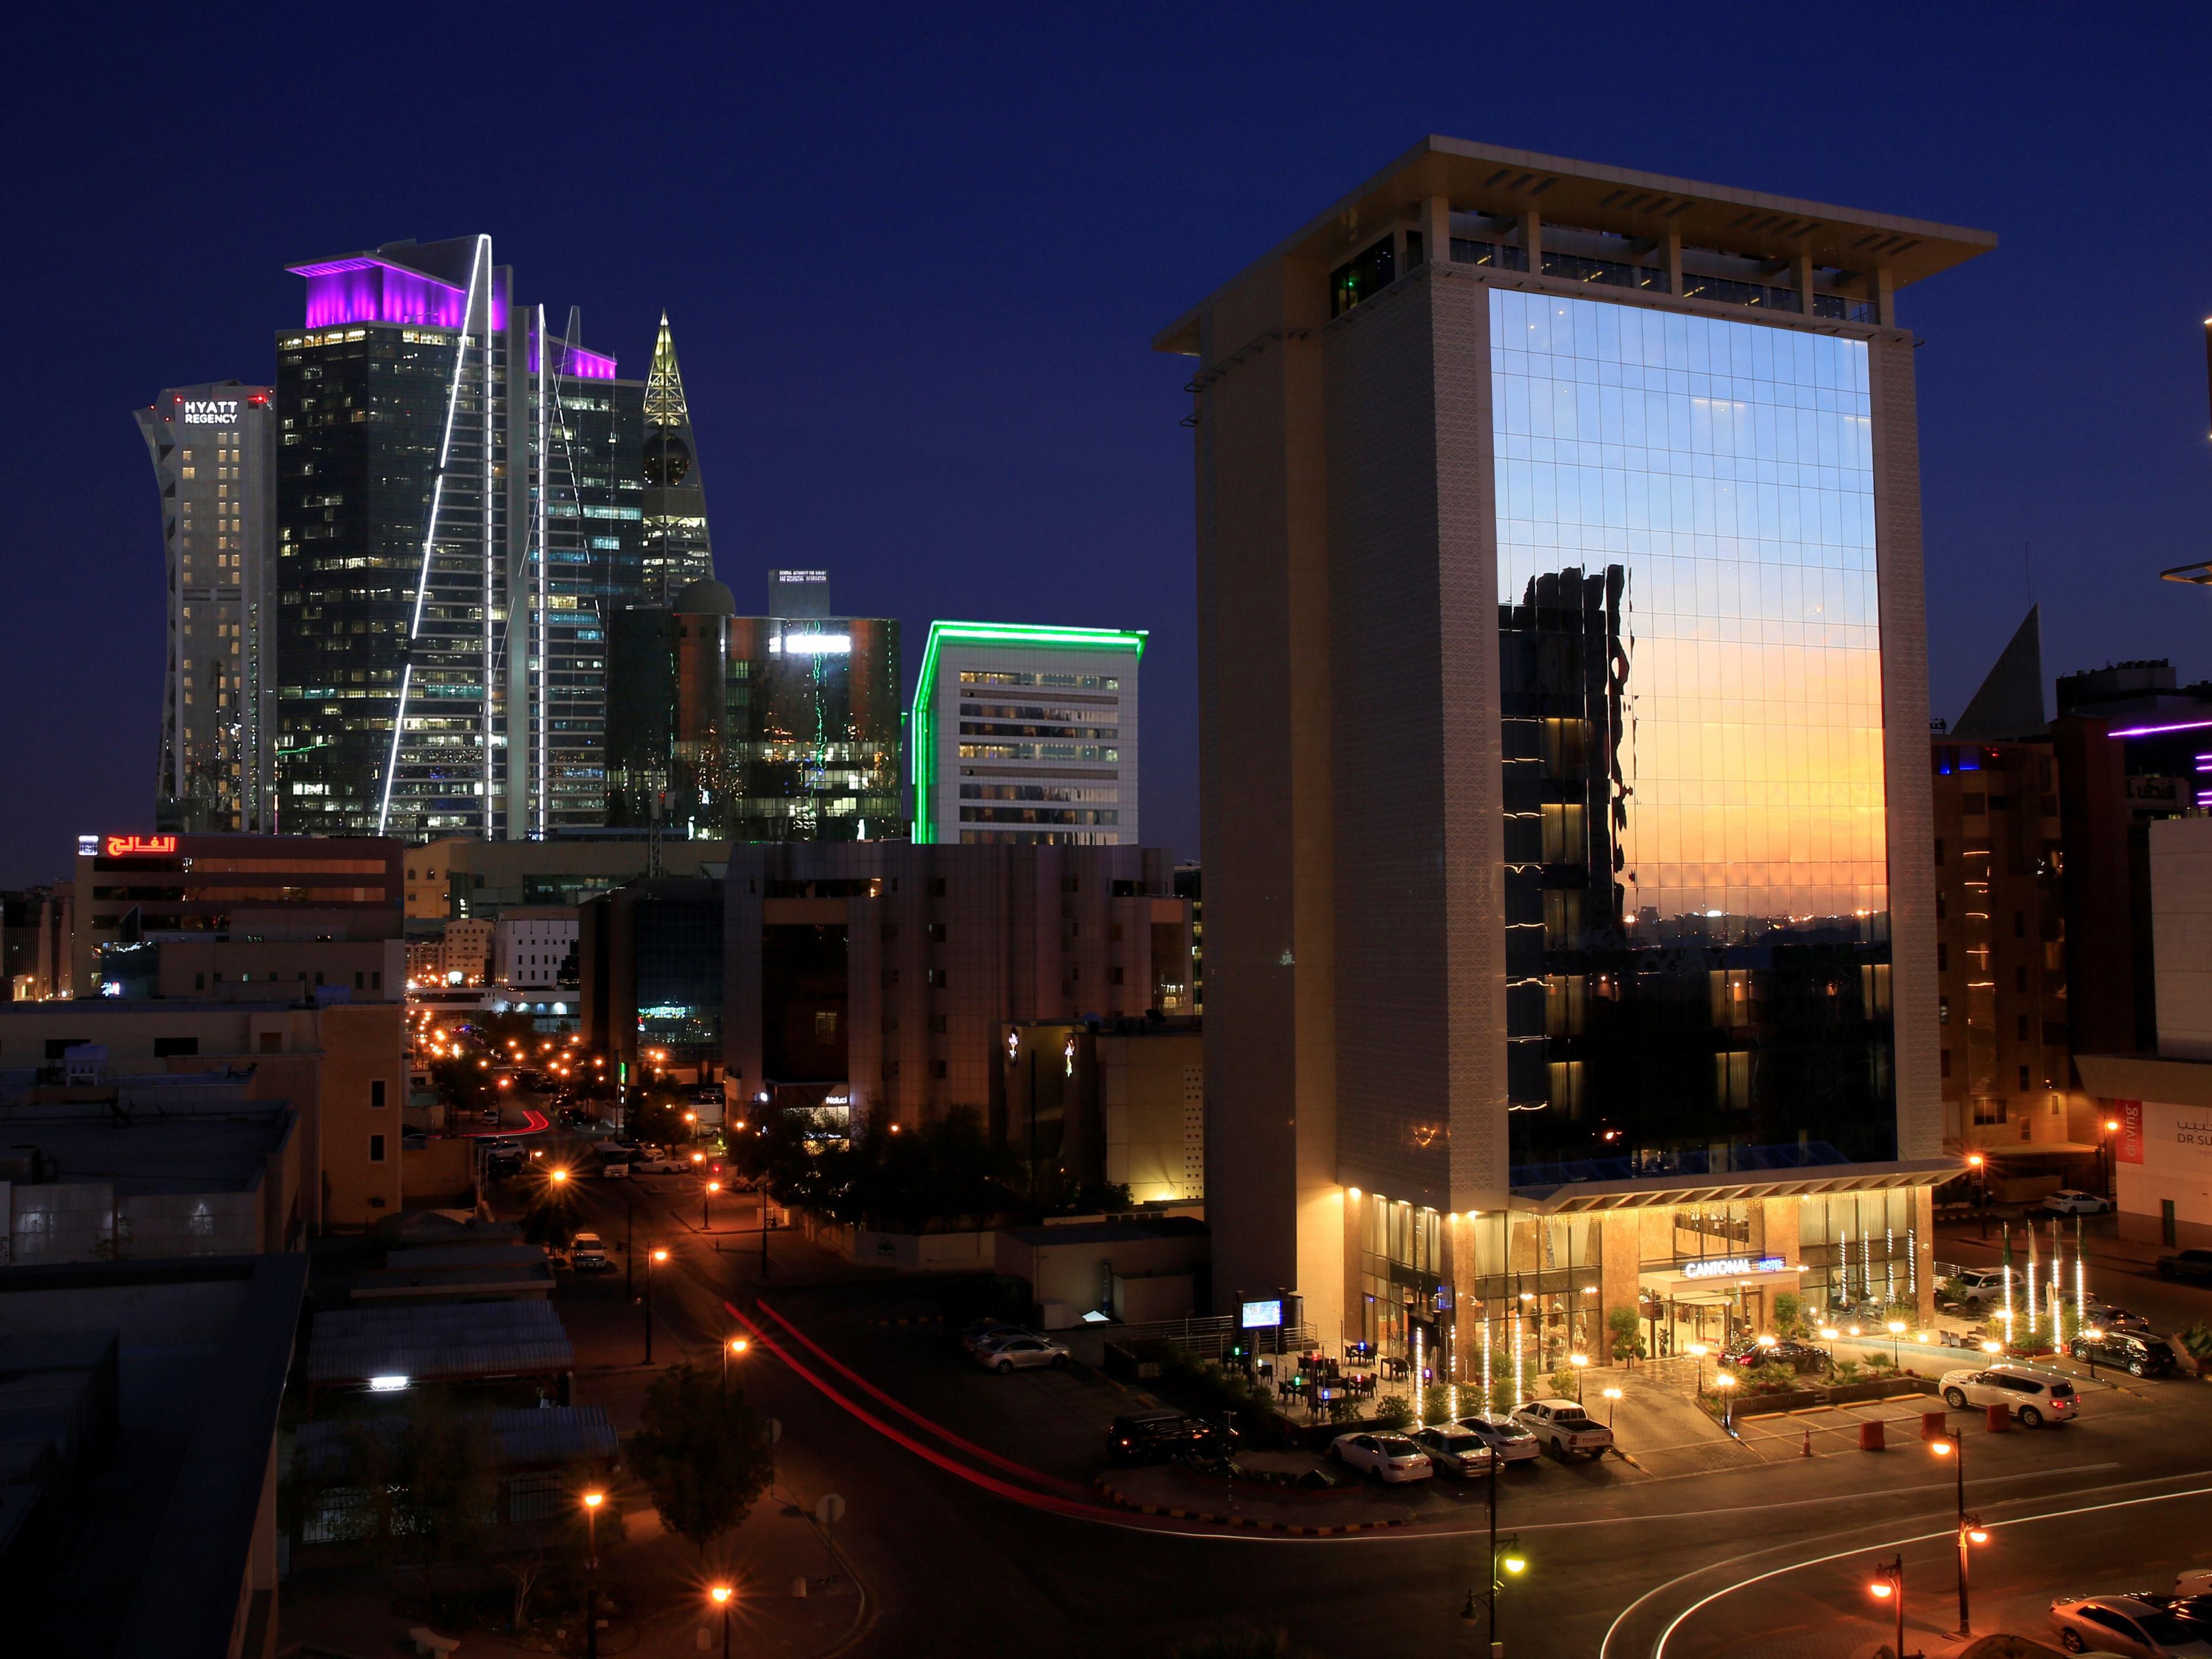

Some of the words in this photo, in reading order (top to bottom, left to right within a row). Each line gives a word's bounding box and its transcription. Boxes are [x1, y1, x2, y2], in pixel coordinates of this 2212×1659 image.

[185, 401, 238, 413] HYATT
[185, 414, 238, 424] REGENCY
[107, 836, 175, 856] الفالح
[2123, 1104, 2139, 1157] driving
[2177, 1133, 2194, 1144] DR
[1685, 1259, 1751, 1278] CANTONAL
[1759, 1259, 1784, 1271] HOTEL
